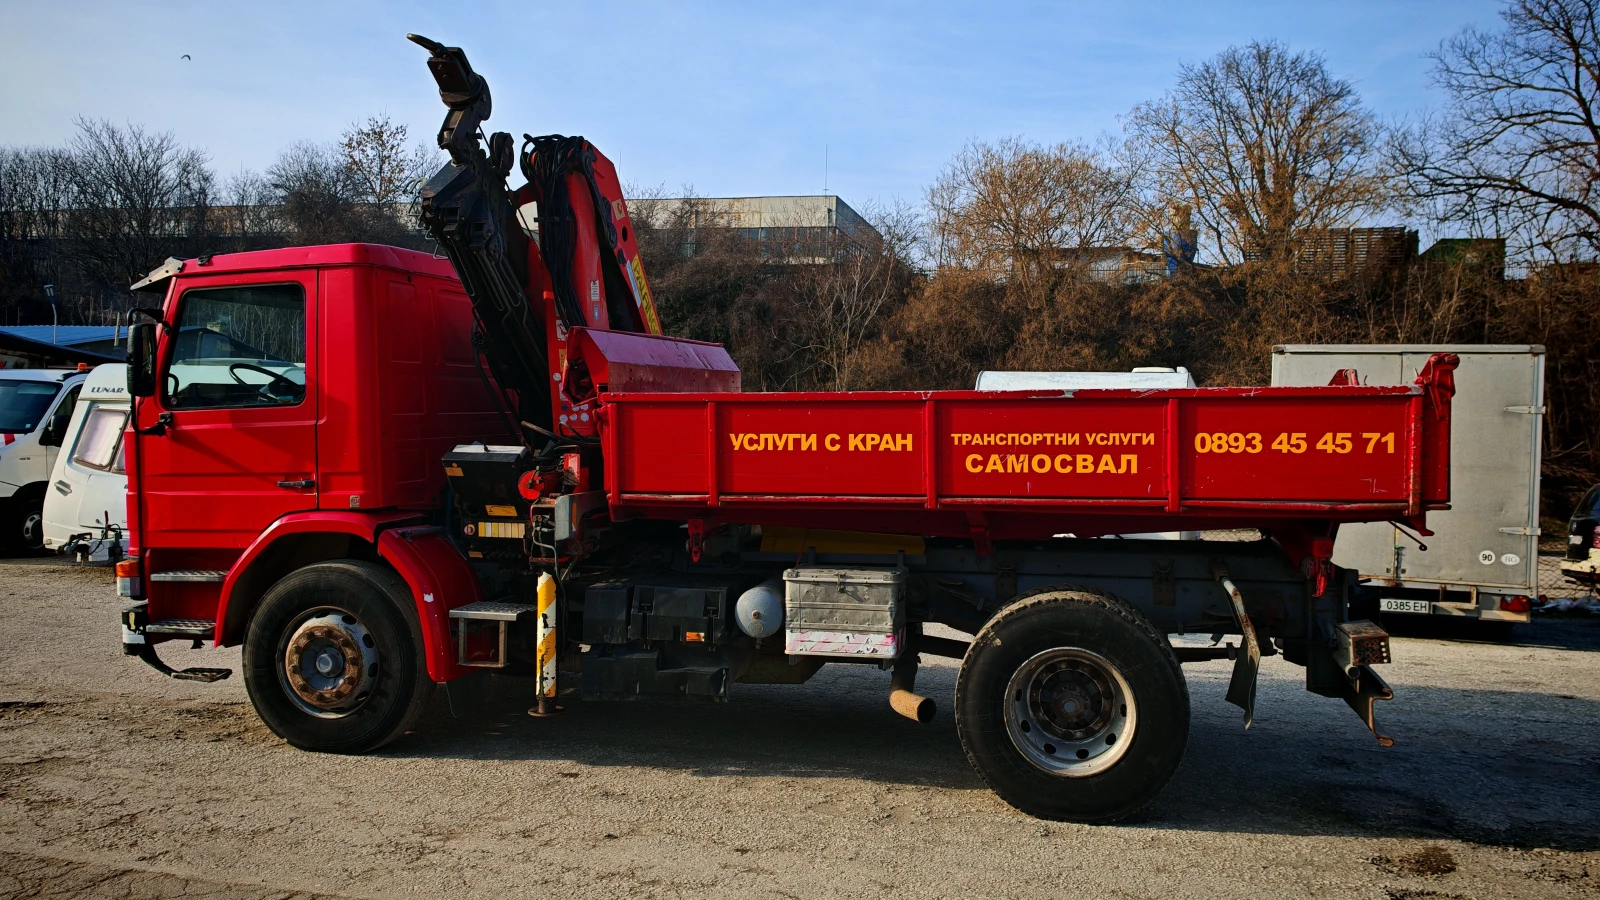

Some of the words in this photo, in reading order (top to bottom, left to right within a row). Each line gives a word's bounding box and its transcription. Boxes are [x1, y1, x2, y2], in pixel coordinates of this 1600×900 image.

[632, 258, 660, 335] PALFING
[91, 386, 124, 394] LUNAR
[729, 433, 817, 452] УСЛУГИ
[824, 433, 841, 452] С
[848, 433, 913, 452] КРАН
[950, 432, 1080, 447] ТРАНСПОРТНИ
[1085, 432, 1155, 446] УСЛУГИ
[1194, 432, 1263, 454] 0893
[1271, 432, 1308, 454] 45
[1315, 432, 1353, 454] 45
[1362, 432, 1395, 454] 71
[965, 453, 1138, 475] САМОСВАЛ
[1481, 553, 1493, 562] 90
[1504, 555, 1518, 563] BG
[1386, 600, 1411, 611] 0385
[1413, 601, 1427, 612] EH
